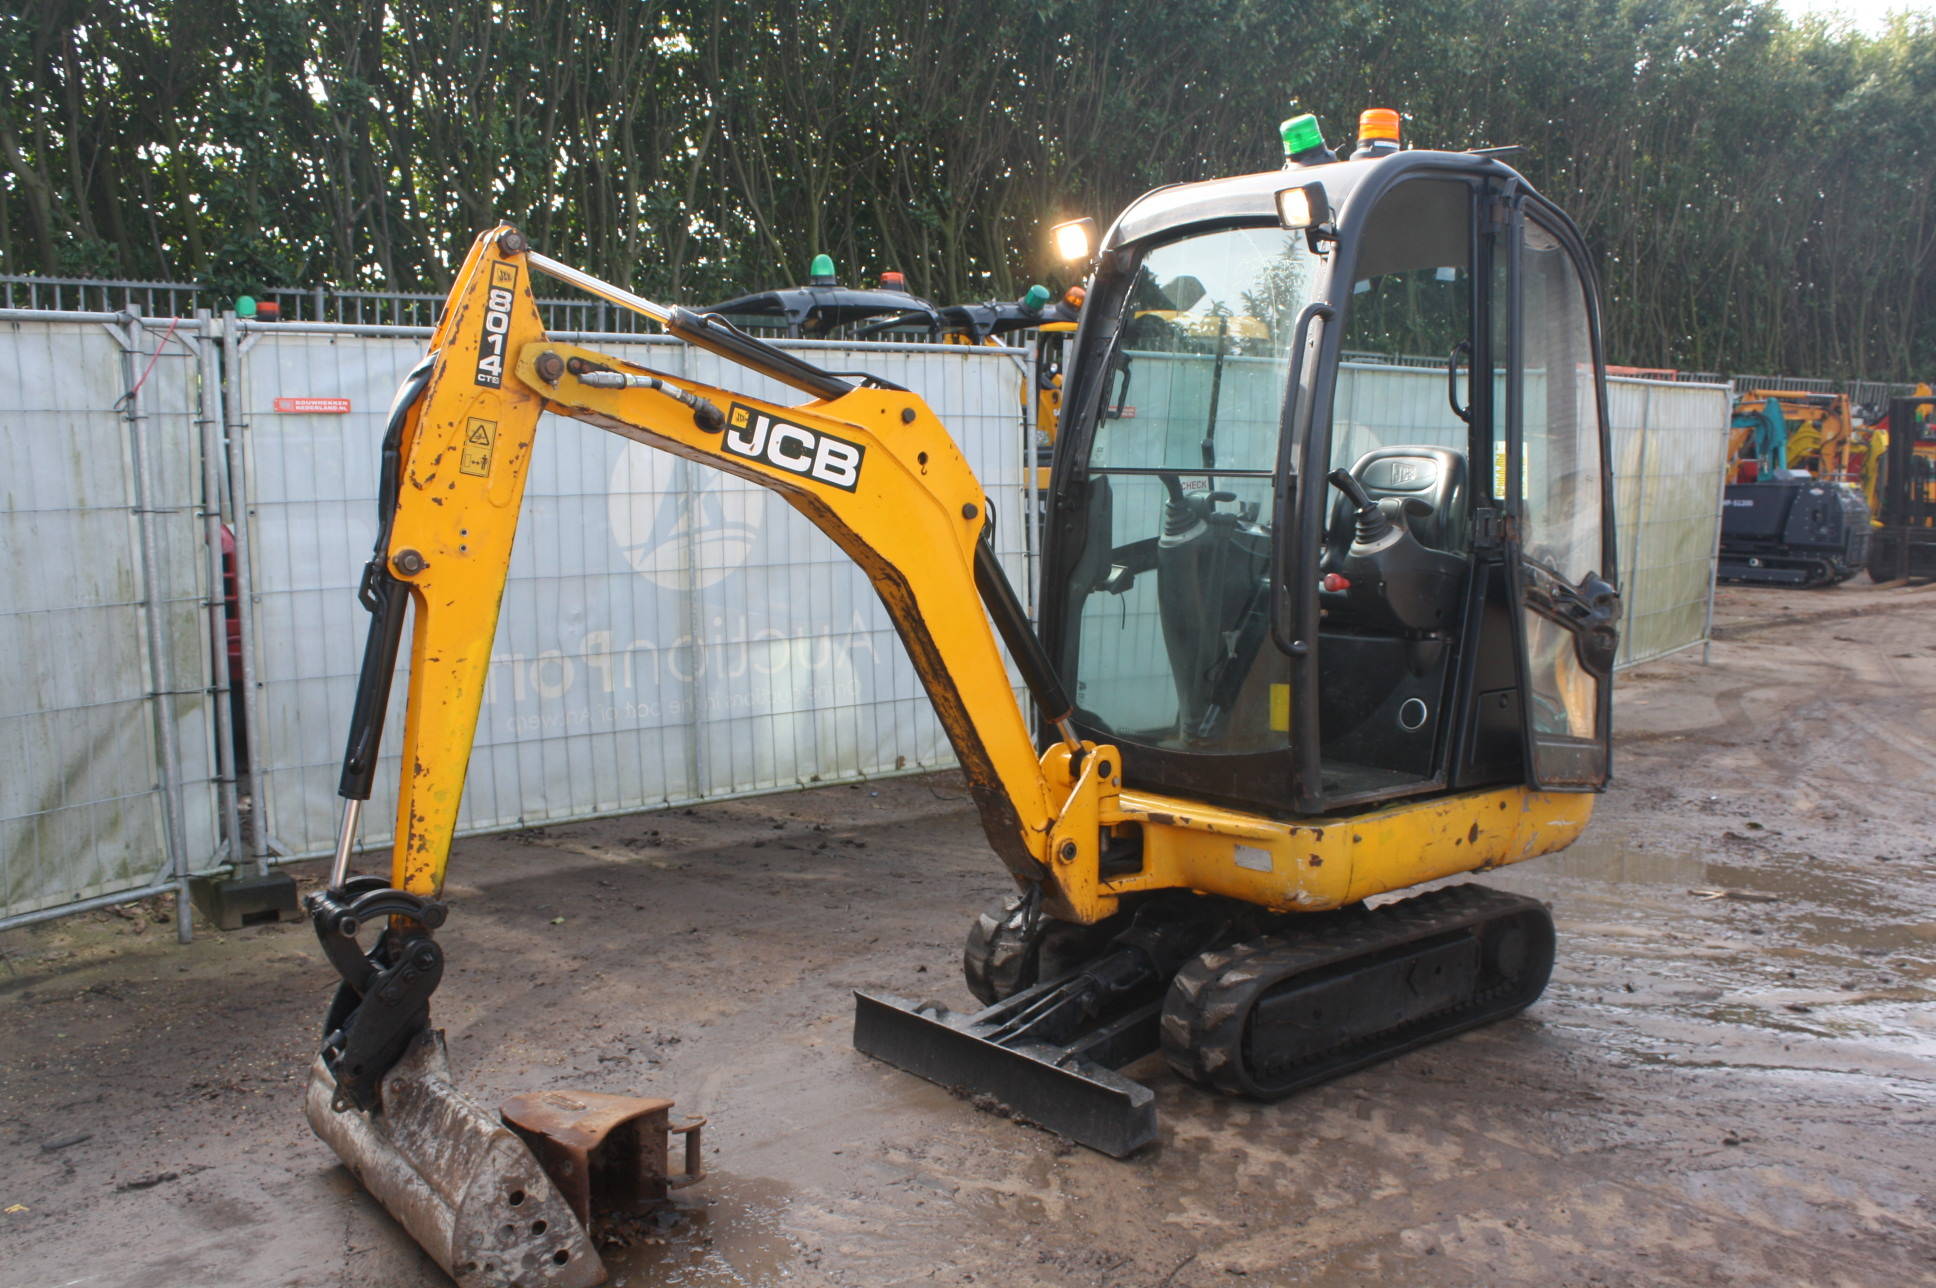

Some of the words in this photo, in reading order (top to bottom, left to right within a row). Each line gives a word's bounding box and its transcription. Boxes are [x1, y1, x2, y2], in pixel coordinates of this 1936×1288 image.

[479, 288, 513, 377] 8014
[727, 415, 860, 487] JCB
[1182, 480, 1207, 490] CHECK
